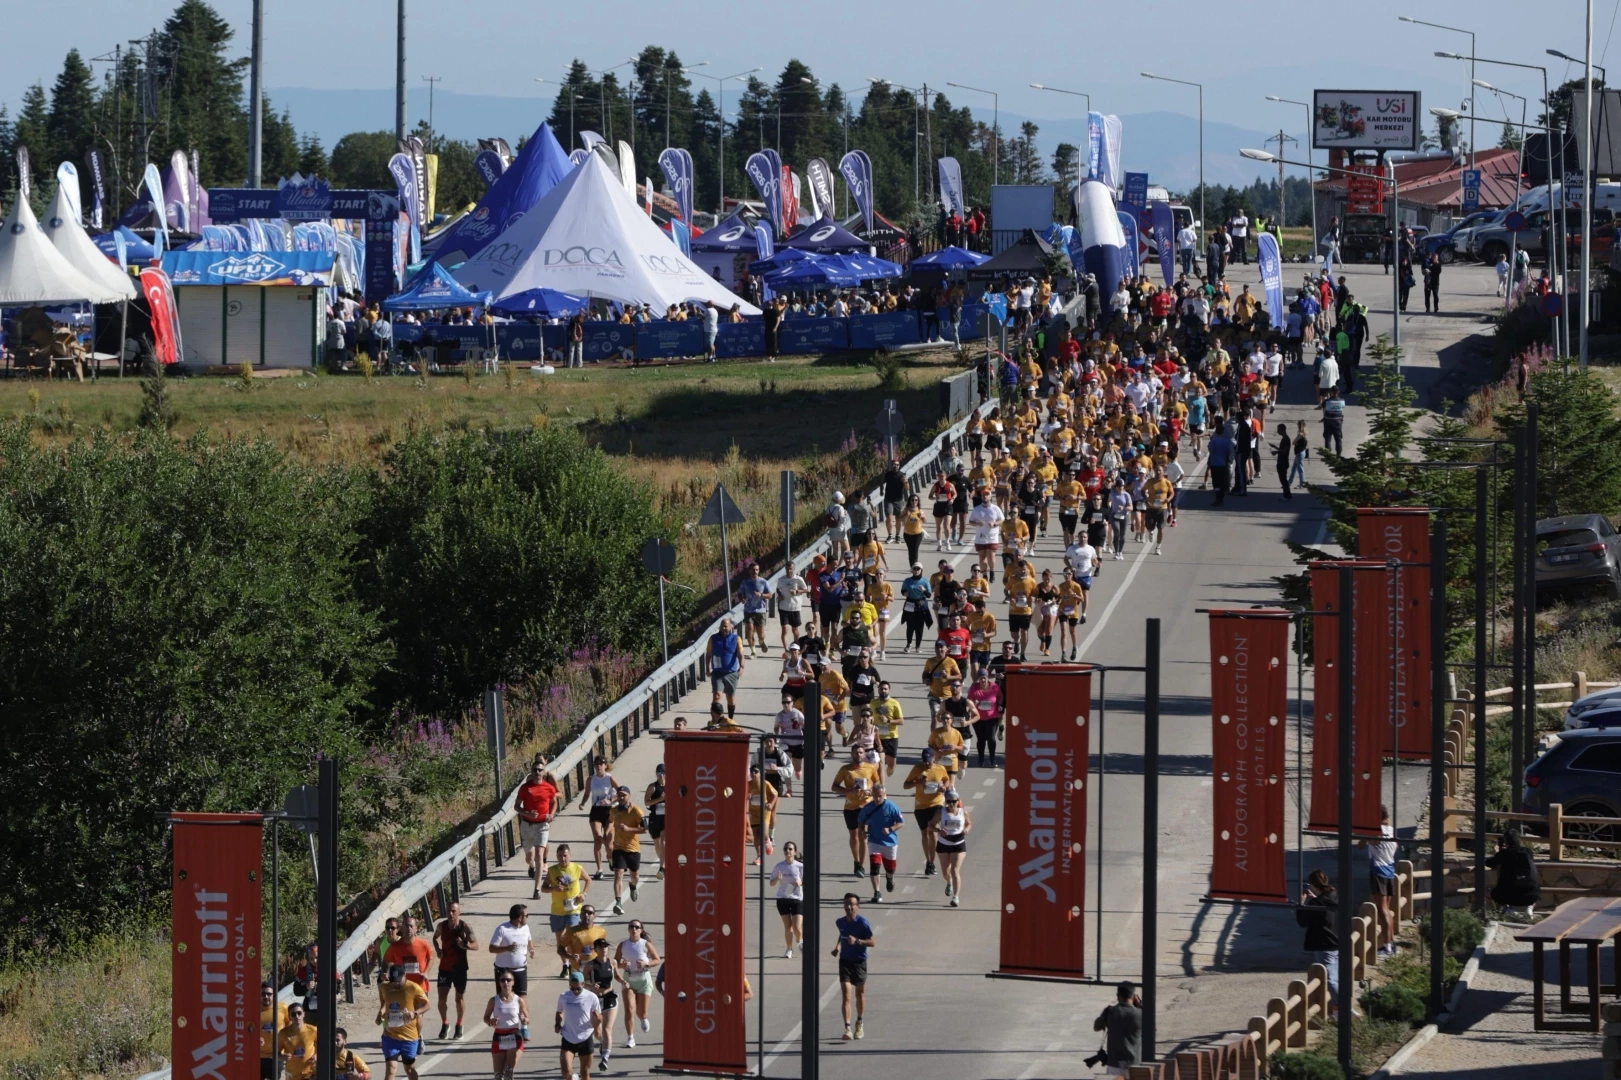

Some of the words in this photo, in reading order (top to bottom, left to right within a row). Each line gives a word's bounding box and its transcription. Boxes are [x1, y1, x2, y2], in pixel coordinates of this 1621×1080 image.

[238, 200, 272, 209] START
[333, 200, 366, 209] START
[1465, 172, 1476, 186] P
[1468, 190, 1475, 199] D
[218, 264, 276, 274] UPUT
[544, 246, 624, 266] DOCA
[1235, 637, 1248, 750] COLLECTION
[1256, 726, 1266, 787] HOTELS
[696, 764, 718, 916] SPLEND'OR
[1018, 729, 1058, 904] Marriott
[1062, 748, 1074, 874] INTERNATIONAL
[1235, 759, 1248, 872] AUTOGRAPH
[191, 888, 228, 1080] Marriott
[235, 912, 245, 1060] INTERNATIONAL
[695, 930, 716, 1034] CEYLAN
